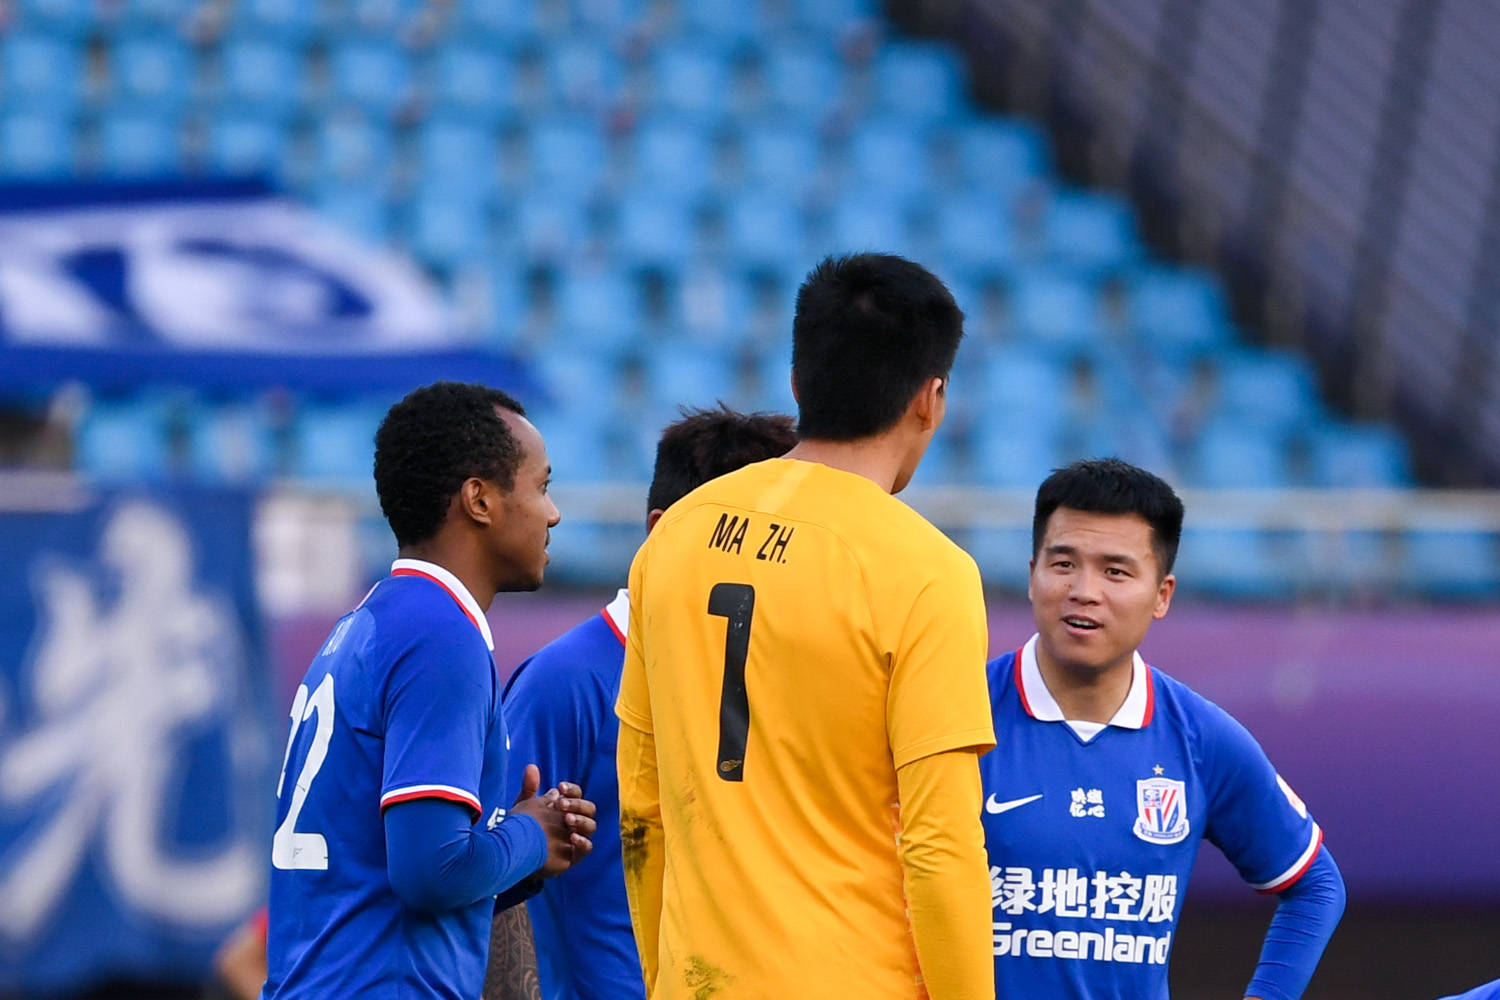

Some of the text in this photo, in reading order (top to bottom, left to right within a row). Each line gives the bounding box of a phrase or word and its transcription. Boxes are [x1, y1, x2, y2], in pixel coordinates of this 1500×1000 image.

[708, 513, 795, 564] MA ZH.
[707, 583, 755, 782] 1
[989, 865, 1178, 923] 绿地控股
[992, 921, 1172, 966] Greenland
